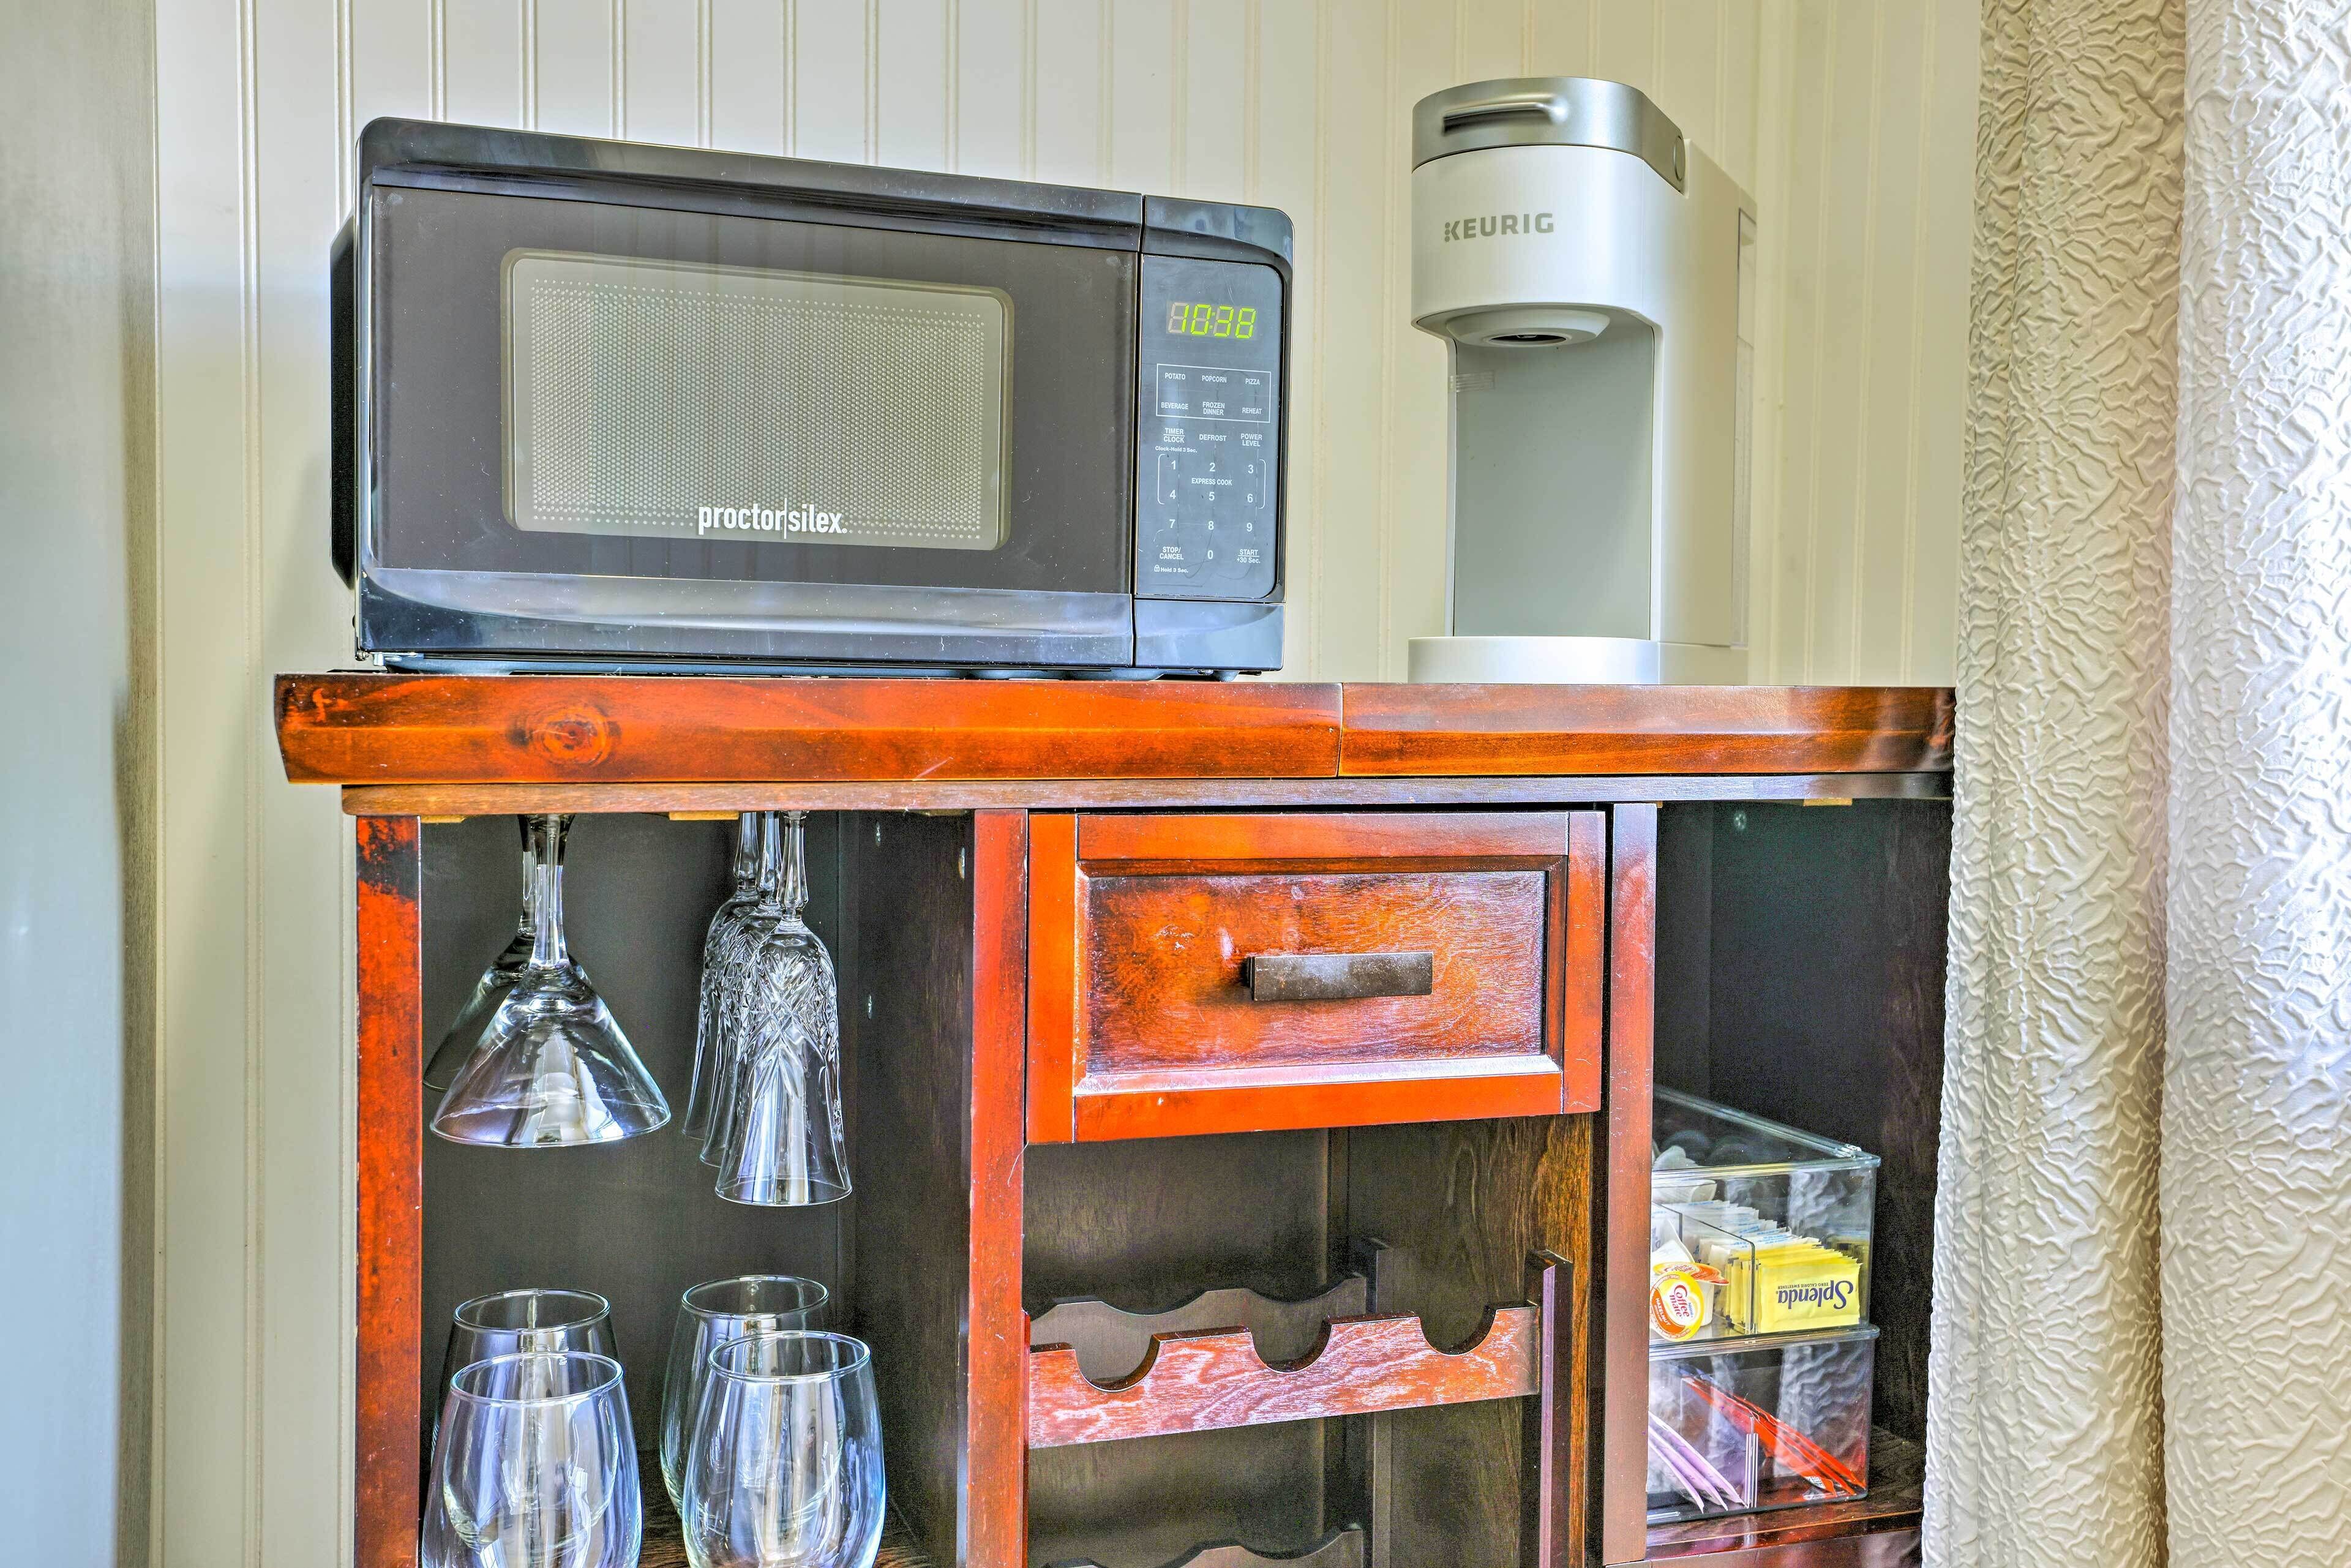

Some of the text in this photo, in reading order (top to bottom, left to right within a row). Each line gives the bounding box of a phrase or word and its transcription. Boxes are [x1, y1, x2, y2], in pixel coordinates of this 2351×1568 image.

[1444, 212, 1554, 242] KEURIG
[1182, 303, 1256, 339] 10:38
[1171, 460, 1176, 470] 1
[1209, 462, 1215, 472] 2
[1248, 464, 1254, 474] 3
[1169, 489, 1176, 499] 4
[1209, 491, 1215, 501] 5
[1247, 493, 1253, 503] 6
[1169, 519, 1176, 528] 7
[1208, 520, 1214, 530] 8
[1247, 522, 1253, 532] 9
[1207, 550, 1213, 560] 0
[1777, 1280, 1854, 1310] Splenda
[1670, 1294, 1682, 1317] mate
[1674, 1285, 1690, 1318] Coffee
[1655, 1298, 1671, 1326] HAZELNUT
